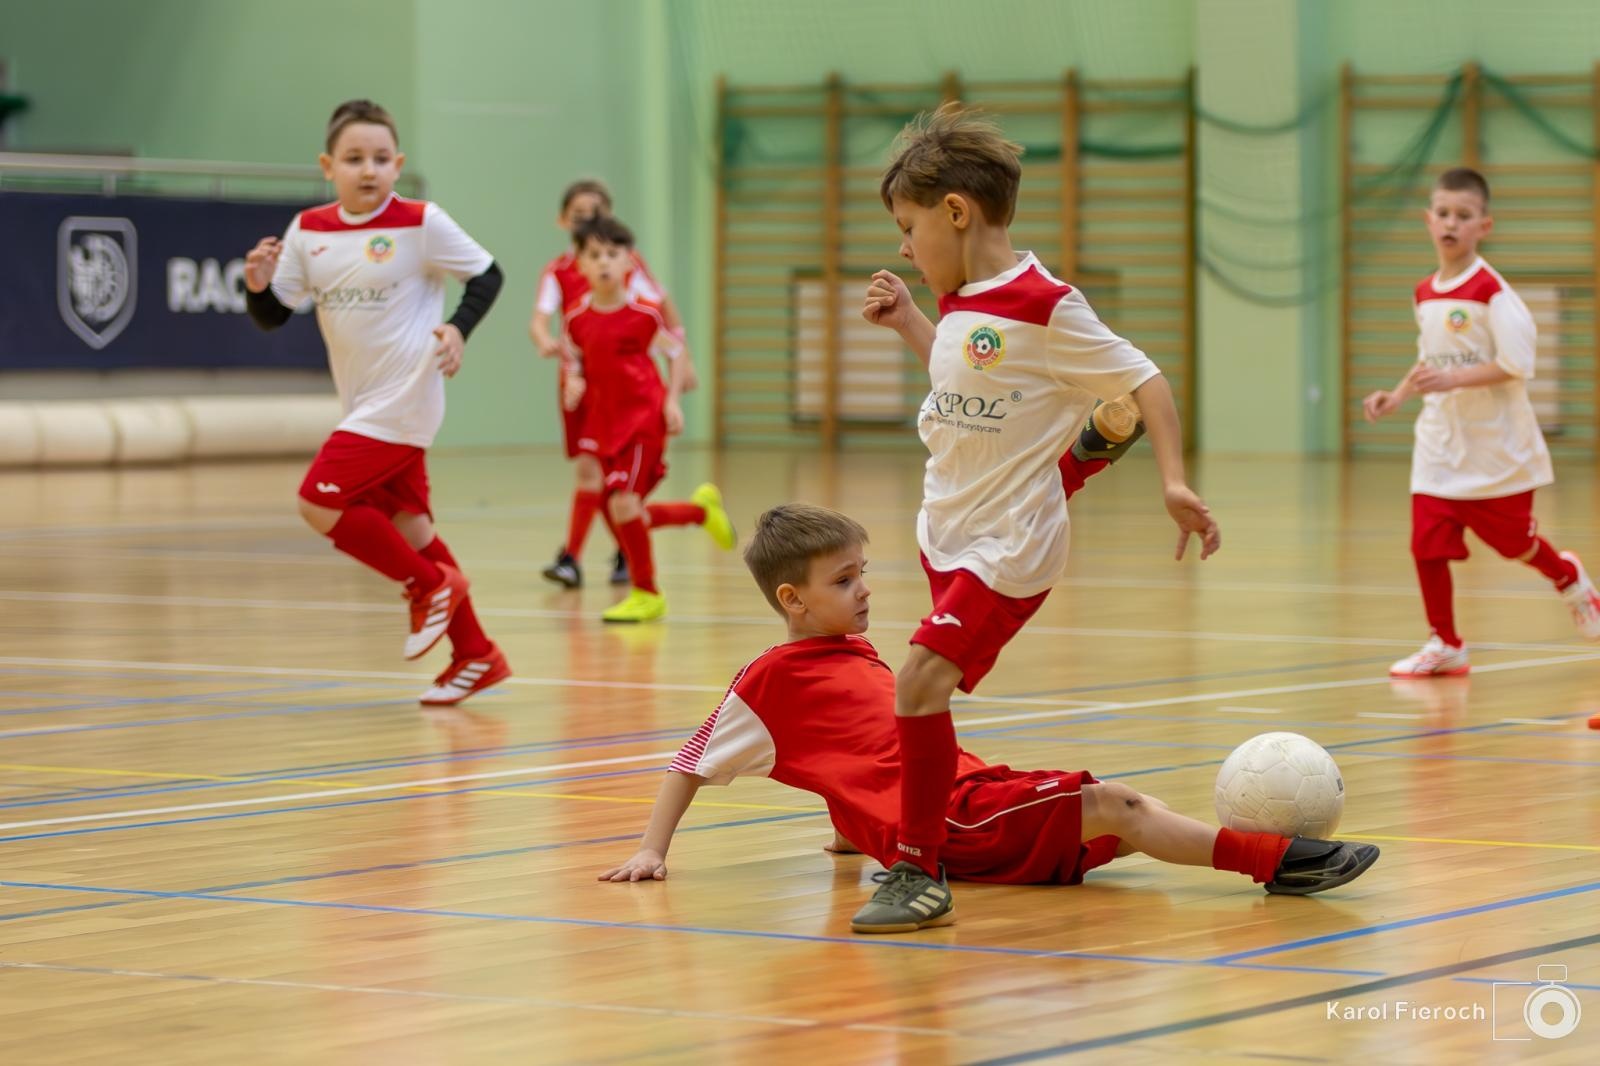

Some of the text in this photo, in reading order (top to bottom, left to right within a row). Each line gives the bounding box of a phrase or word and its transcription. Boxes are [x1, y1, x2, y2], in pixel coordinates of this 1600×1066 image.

[166, 256, 249, 314] RAC
[921, 391, 1008, 420] KPOL
[897, 841, 923, 857] oma
